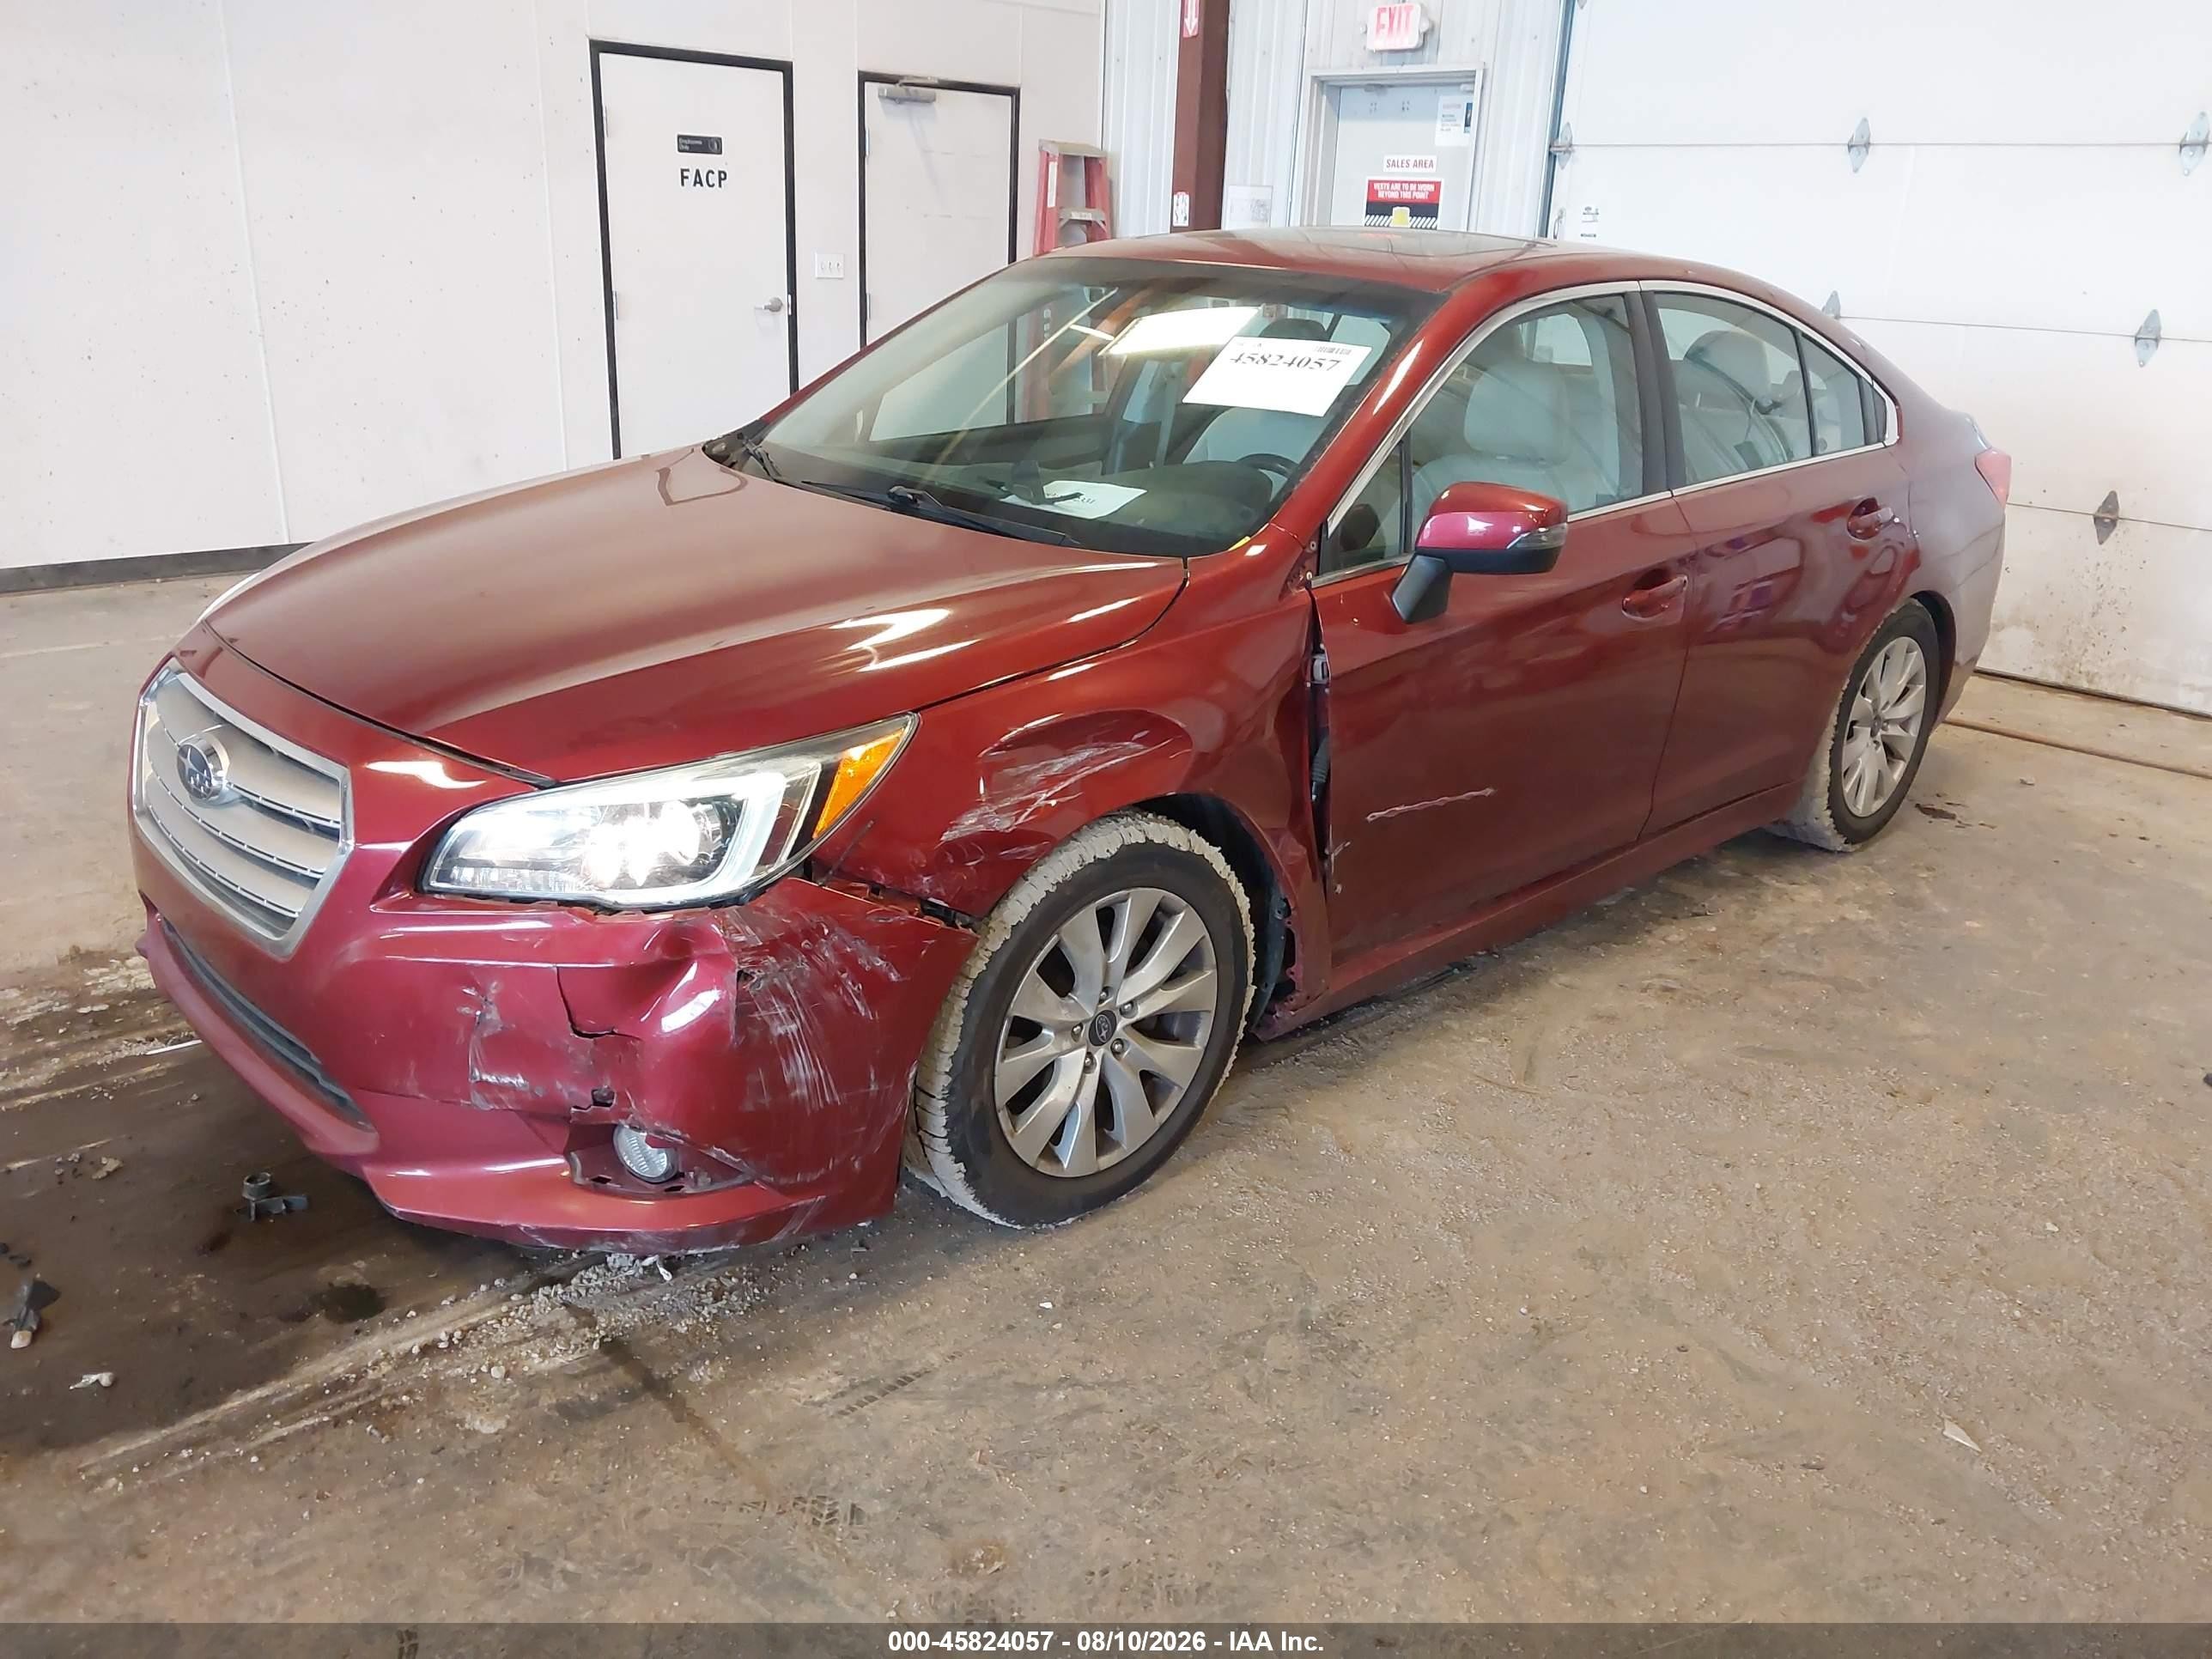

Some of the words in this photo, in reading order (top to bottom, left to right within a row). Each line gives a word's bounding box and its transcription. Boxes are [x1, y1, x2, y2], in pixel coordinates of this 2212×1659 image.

[1375, 5, 1413, 36] EXIT
[1386, 159, 1410, 168] SALES
[1413, 159, 1433, 169] AREA
[680, 167, 727, 188] FACP
[1230, 352, 1342, 371] 45824057
